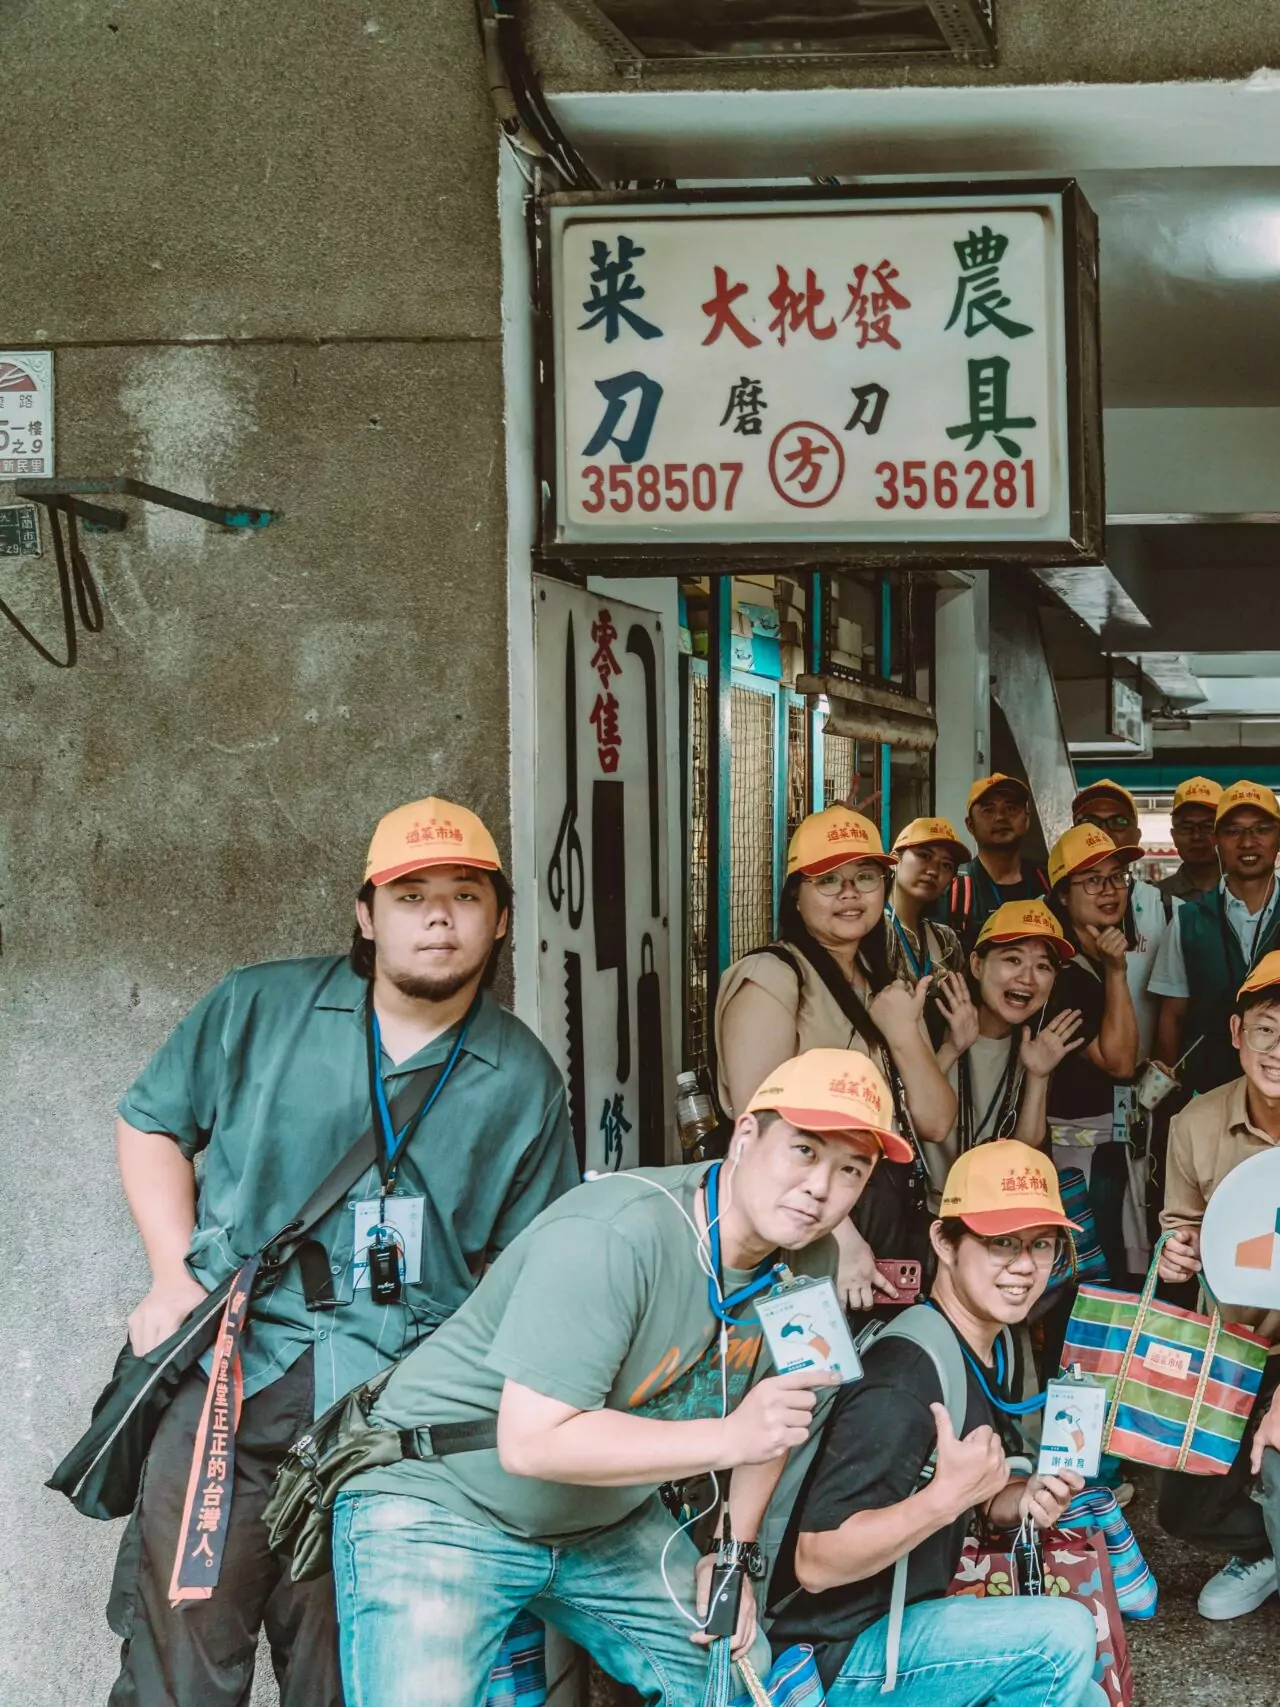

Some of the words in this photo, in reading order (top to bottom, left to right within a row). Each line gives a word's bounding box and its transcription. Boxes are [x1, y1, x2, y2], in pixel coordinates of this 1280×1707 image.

[701, 259, 912, 350] 大批發
[577, 235, 664, 464] 菜刀
[944, 226, 1037, 458] 農具
[719, 376, 890, 436] 磨刀
[2, 459, 42, 473] 新民里
[581, 463, 743, 513] 358507
[875, 459, 1035, 510] 356281
[589, 608, 622, 774] 零售
[600, 1097, 632, 1167] 修
